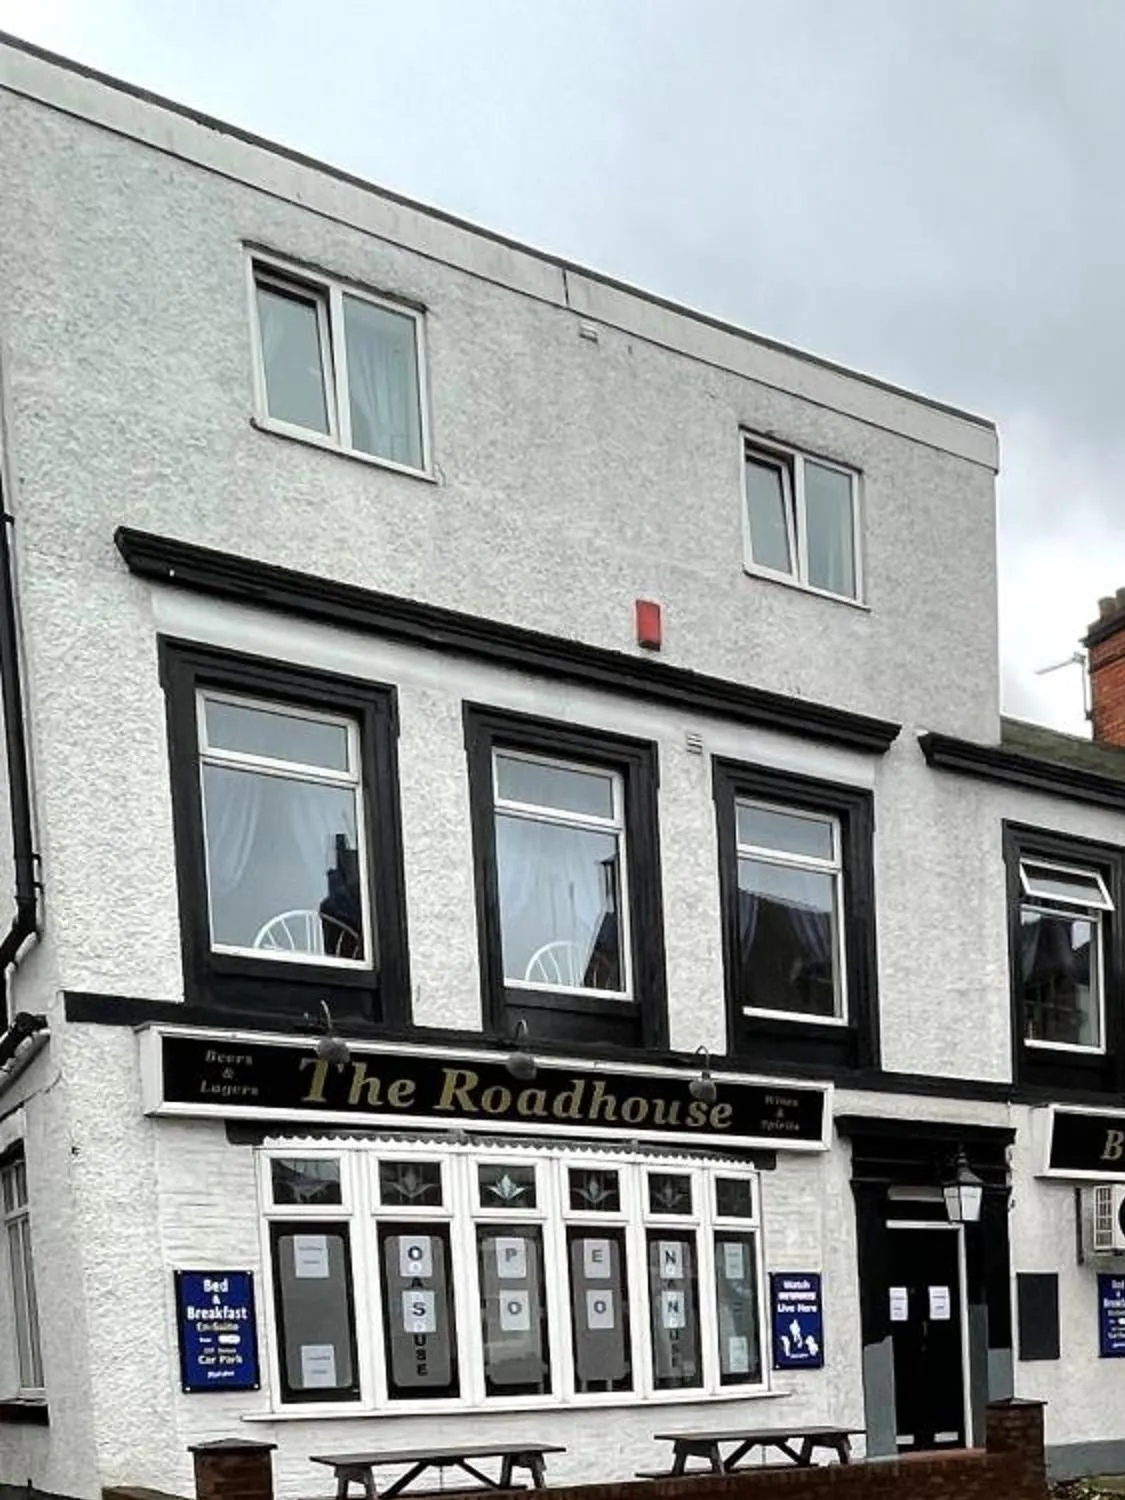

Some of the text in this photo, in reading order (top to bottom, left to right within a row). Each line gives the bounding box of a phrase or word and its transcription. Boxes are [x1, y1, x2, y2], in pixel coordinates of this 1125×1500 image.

[205, 1050, 253, 1066] Beers
[200, 1079, 260, 1097] Lagers
[299, 1058, 734, 1130] The Roadhouse
[203, 1278, 229, 1293] Bed
[186, 1305, 249, 1320] Breakfast
[777, 1303, 795, 1313] Live
[198, 1355, 243, 1365] Car Park
